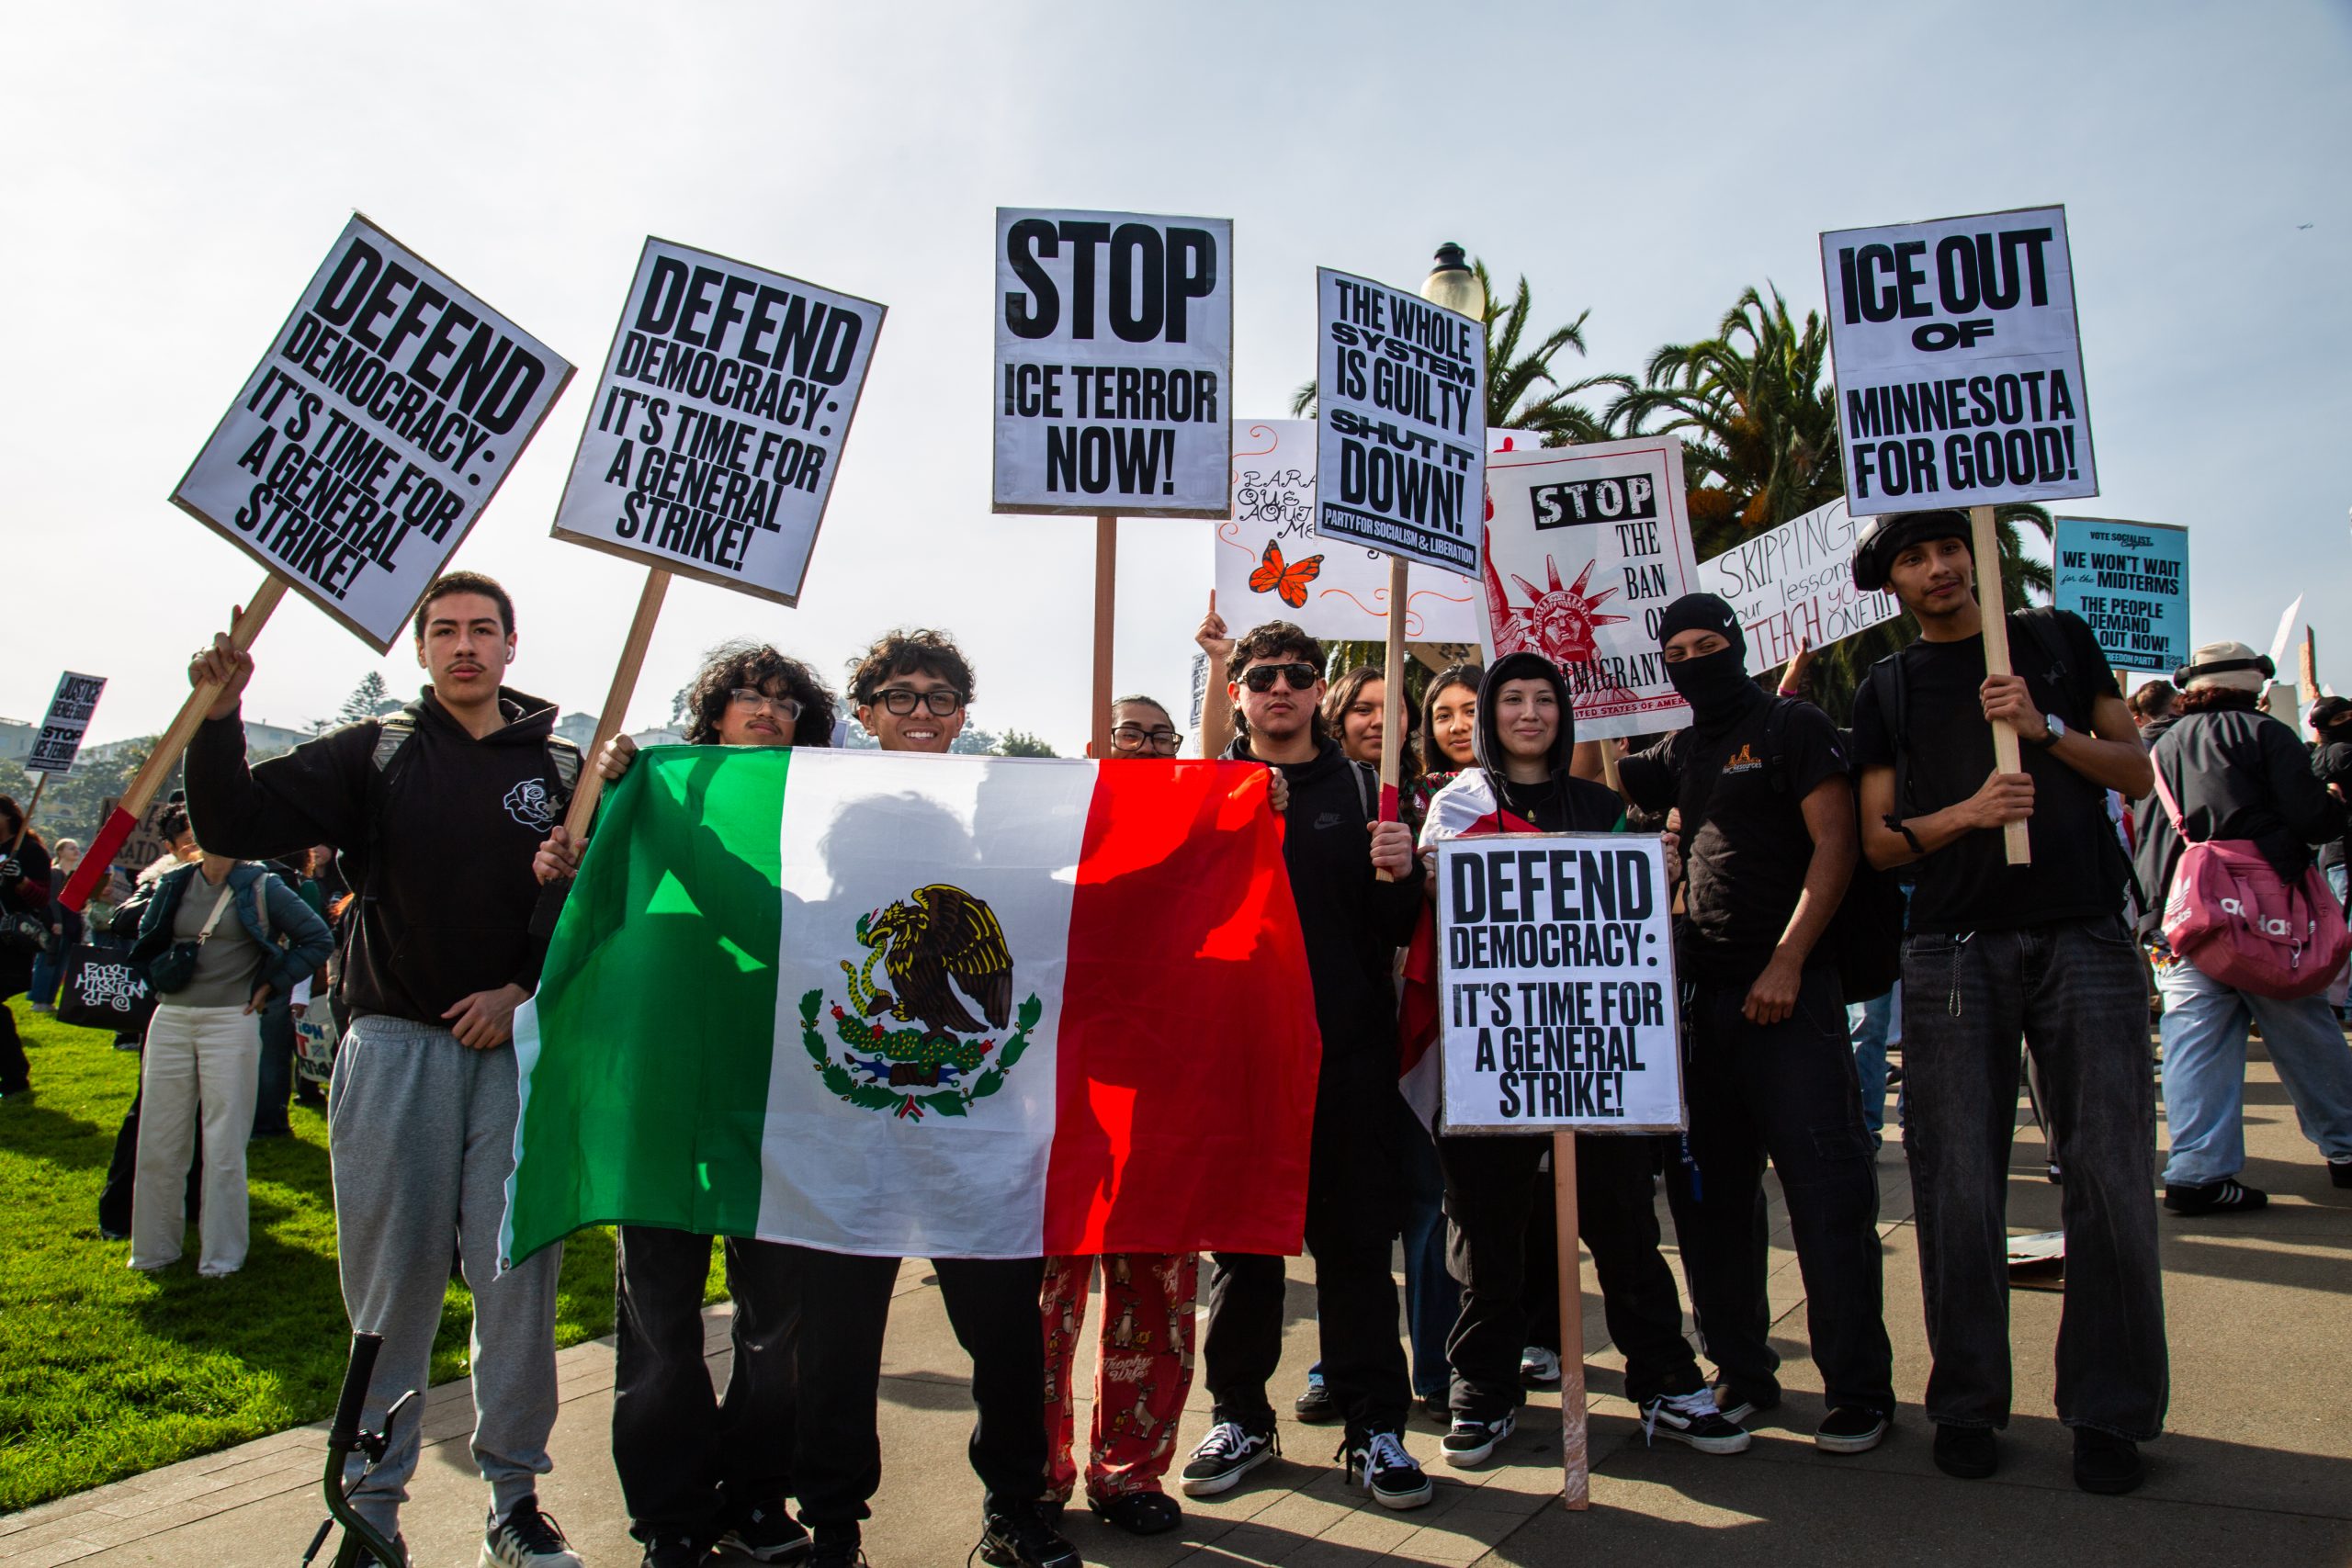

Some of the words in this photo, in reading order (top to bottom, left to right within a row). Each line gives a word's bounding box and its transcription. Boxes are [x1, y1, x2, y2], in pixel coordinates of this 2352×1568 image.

[1005, 219, 1216, 344] STOP
[1838, 241, 1933, 324] ICE
[1936, 228, 2052, 314] OUT
[312, 237, 545, 435] DEFEND
[634, 255, 862, 387] DEFEND
[1335, 278, 1385, 333] THE
[1389, 295, 1472, 365] WHOLE
[1912, 318, 1994, 352] OF
[615, 331, 838, 436] DEMOCRACY:
[1331, 322, 1476, 388] SYSTEM
[281, 311, 495, 486] DEMOCRACY:
[1005, 364, 1063, 418] ICE
[1071, 366, 1217, 423] TERROR
[1337, 345, 1367, 401] IS
[1374, 356, 1471, 436] GUILTY
[1847, 369, 2075, 439] MINNESOTA
[246, 366, 323, 442] IT'S
[312, 409, 401, 496] TIME
[383, 463, 466, 545] FOR
[598, 386, 668, 446] IT'S
[662, 405, 757, 473] TIME
[752, 431, 827, 493] FOR
[1046, 425, 1175, 495] NOW!
[1330, 409, 1437, 459] SHUT
[1442, 443, 1475, 472] IT
[1852, 438, 1939, 499] FOR
[1944, 425, 2079, 491] GOOD!
[237, 428, 277, 476] A
[266, 443, 413, 573] GENERAL
[605, 438, 634, 488] A
[636, 447, 784, 533] GENERAL
[1238, 489, 1299, 506] QUE
[1340, 437, 1464, 537] DOWN!
[1536, 478, 1651, 524] STOP
[235, 483, 369, 601] STRIKE!
[616, 491, 755, 571] STRIKE!
[1325, 509, 1354, 532] PARTY
[1355, 517, 1373, 536] FOR
[1374, 523, 1418, 547] SOCIALISM
[1419, 534, 1428, 550] &
[1430, 537, 1474, 565] LIBERATION
[1615, 522, 1661, 558] THE
[1720, 501, 1856, 598] SKIPPING
[2089, 531, 2109, 540] VOTE
[2111, 533, 2151, 546] SOCIALIST
[1623, 564, 1668, 600] BAN
[2060, 574, 2076, 585] for
[2078, 575, 2094, 583] the
[2098, 571, 2178, 595] MIDTERMS
[2063, 551, 2086, 568] WE
[2091, 553, 2139, 572] WON'T
[2143, 558, 2180, 577] WAIT
[1734, 600, 1762, 626] our
[1745, 595, 1823, 669] TEACH
[1827, 592, 1893, 640] ONE!!!
[2081, 596, 2107, 613] THE
[2111, 598, 2163, 618] PEOPLE
[2088, 614, 2150, 633] DEMAND
[2099, 631, 2127, 648] OUT
[2132, 634, 2169, 652] NOW!
[2106, 654, 2132, 663] REEDOM
[2134, 656, 2155, 665] PARTY
[41, 726, 84, 741] STOP
[1575, 708, 1600, 717] ITED
[1600, 705, 1637, 715] STATES
[1641, 700, 1654, 710] OF
[1657, 697, 1684, 707] AMER
[1451, 851, 1653, 924] DEFEND
[1450, 923, 1657, 969] DEMOCRACY:
[1453, 983, 1512, 1027] IT'S
[1517, 982, 1595, 1027] TIME
[1600, 982, 1664, 1026] FOR
[1476, 1027, 1497, 1072] A
[1502, 1026, 1645, 1072] GENERAL
[1499, 1072, 1624, 1117] STRIKE!
[1103, 1354, 1154, 1371] Trophy
[1109, 1366, 1148, 1382] Wife
